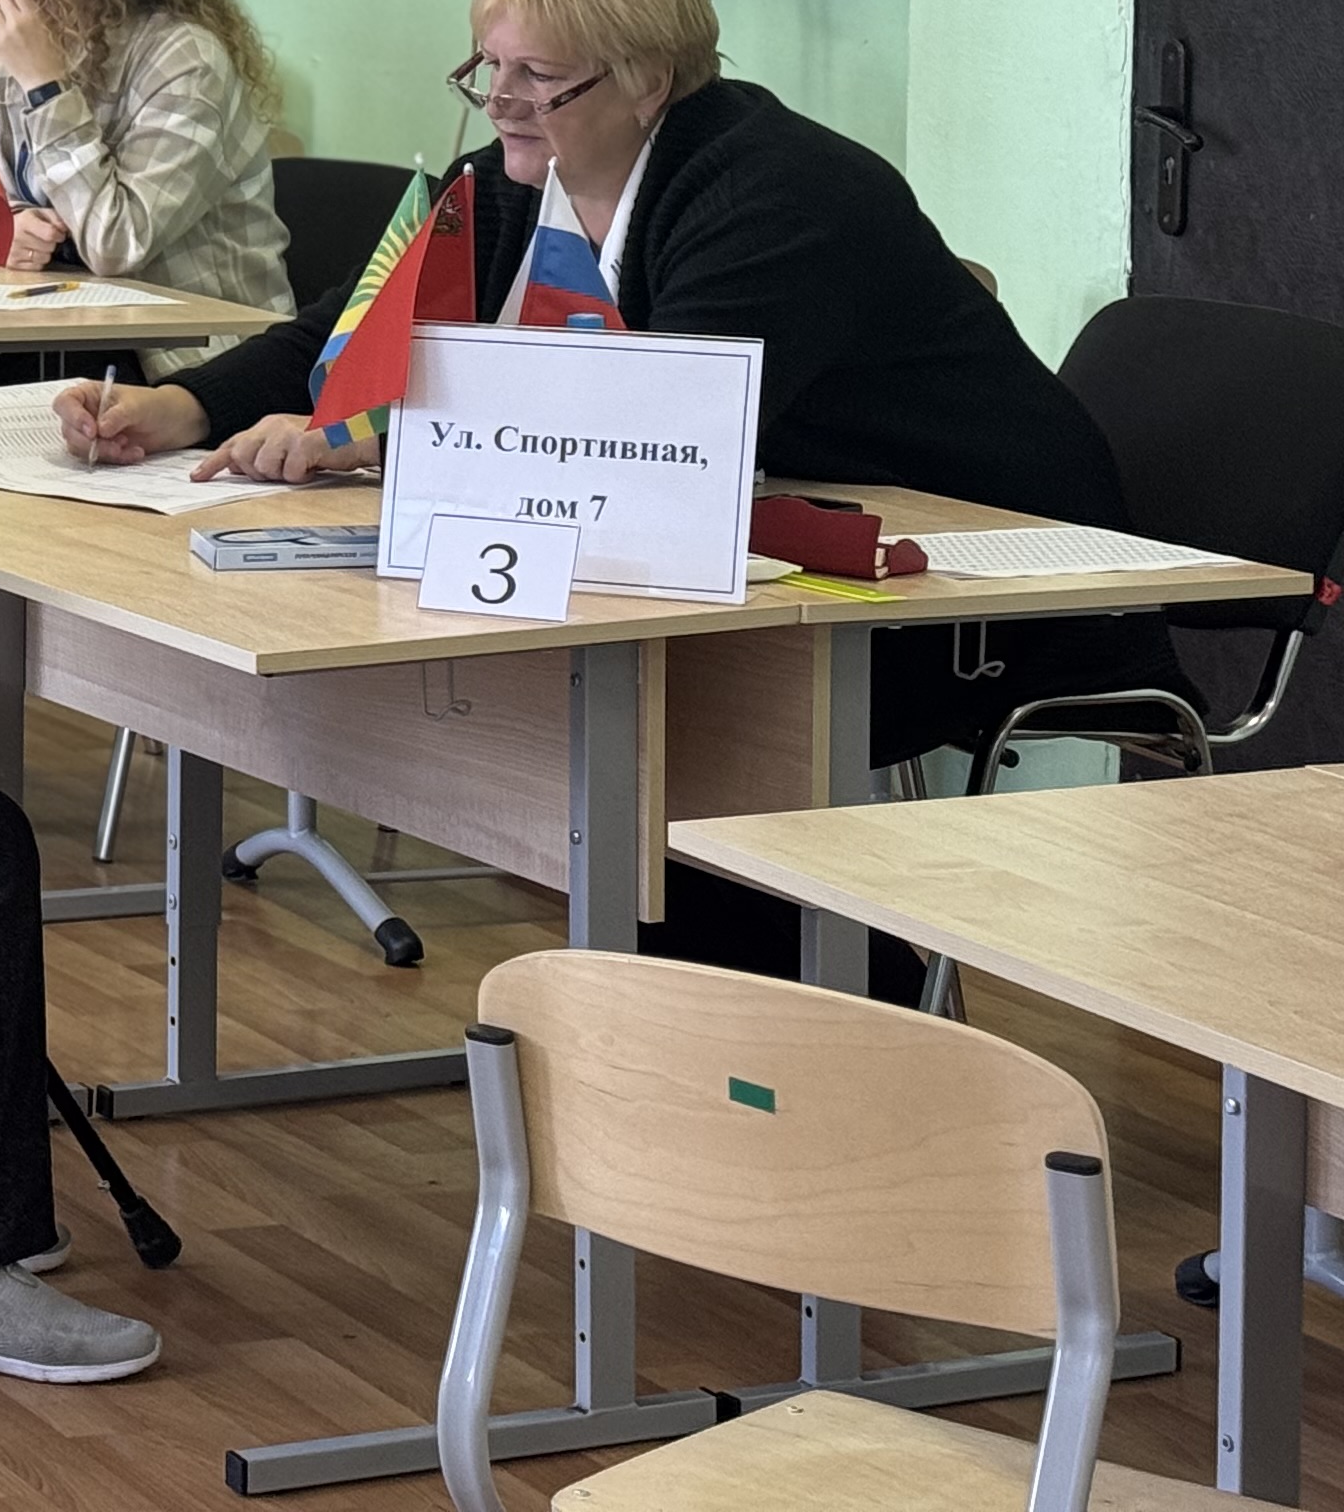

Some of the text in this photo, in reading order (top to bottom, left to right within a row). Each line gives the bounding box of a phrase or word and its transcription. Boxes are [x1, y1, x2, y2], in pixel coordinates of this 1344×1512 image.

[429, 421, 709, 470] Ул. Спортивная,
[515, 494, 608, 522] дом 7
[471, 543, 519, 605] 3
